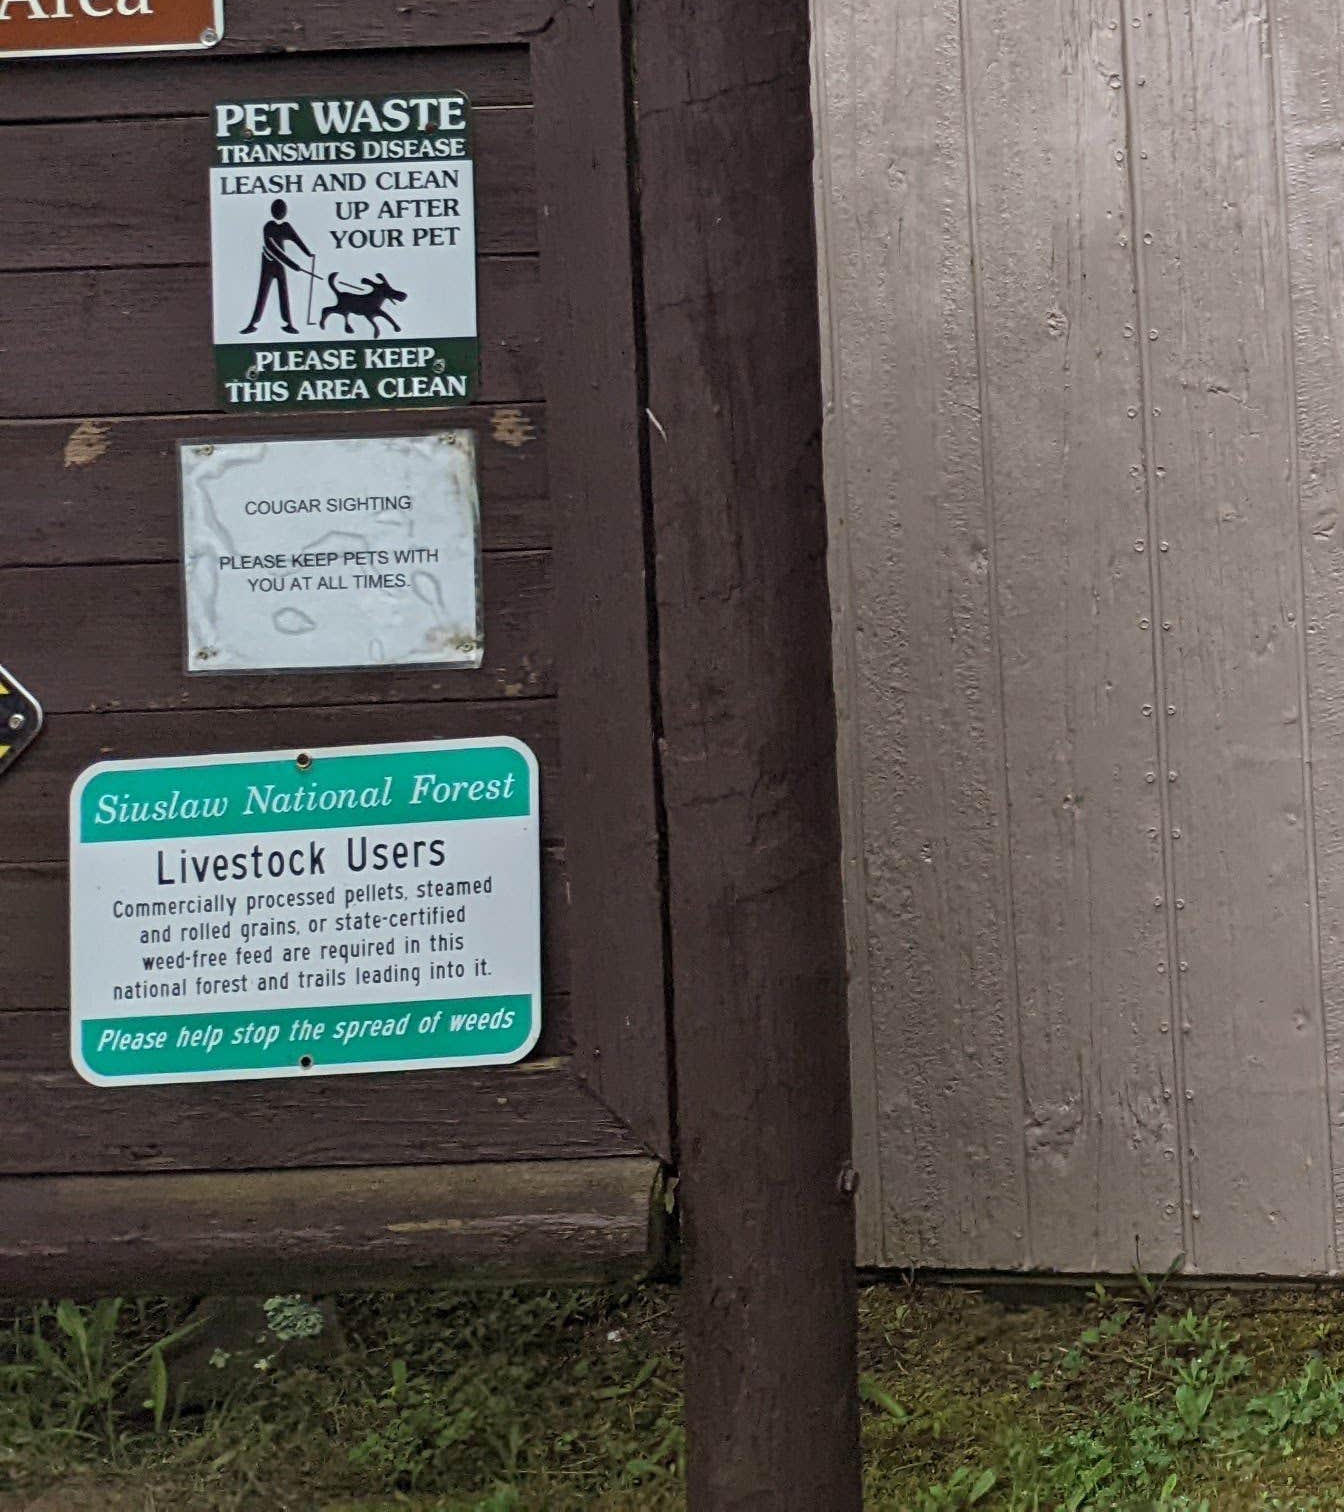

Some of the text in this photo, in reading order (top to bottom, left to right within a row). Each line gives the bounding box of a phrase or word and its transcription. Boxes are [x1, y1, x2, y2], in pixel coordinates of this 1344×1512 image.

[216, 97, 466, 136] PET WASTE
[218, 137, 465, 164] TRANSMITS DISEASE
[220, 169, 459, 195] LEASH AND CLEAN
[335, 198, 460, 220] UP AFTER
[330, 227, 460, 249] YOUR PET
[255, 347, 436, 372] PLEASE KEEP
[225, 376, 467, 403] THIS AREA CLEAN
[245, 495, 412, 516] COUGAR SIGHTING
[219, 548, 439, 570] PLEASE KEEP PETS WITH
[247, 576, 286, 592] YOU
[290, 576, 312, 590] AT
[316, 576, 348, 590] ALL
[94, 772, 516, 825] Siuslaw National Forest
[157, 836, 446, 886] Livestock Users
[113, 896, 236, 919] Commercially
[247, 887, 336, 912] processed
[416, 876, 492, 898] steamed
[140, 925, 172, 943] and
[181, 922, 231, 941] rolled
[308, 917, 328, 933] or
[335, 906, 466, 931] state-certified
[142, 934, 464, 971] weed-free feed are required in this
[113, 959, 492, 1001] national forest and trails leading into it.
[98, 1008, 516, 1052] Please help stop the spread of weeds
